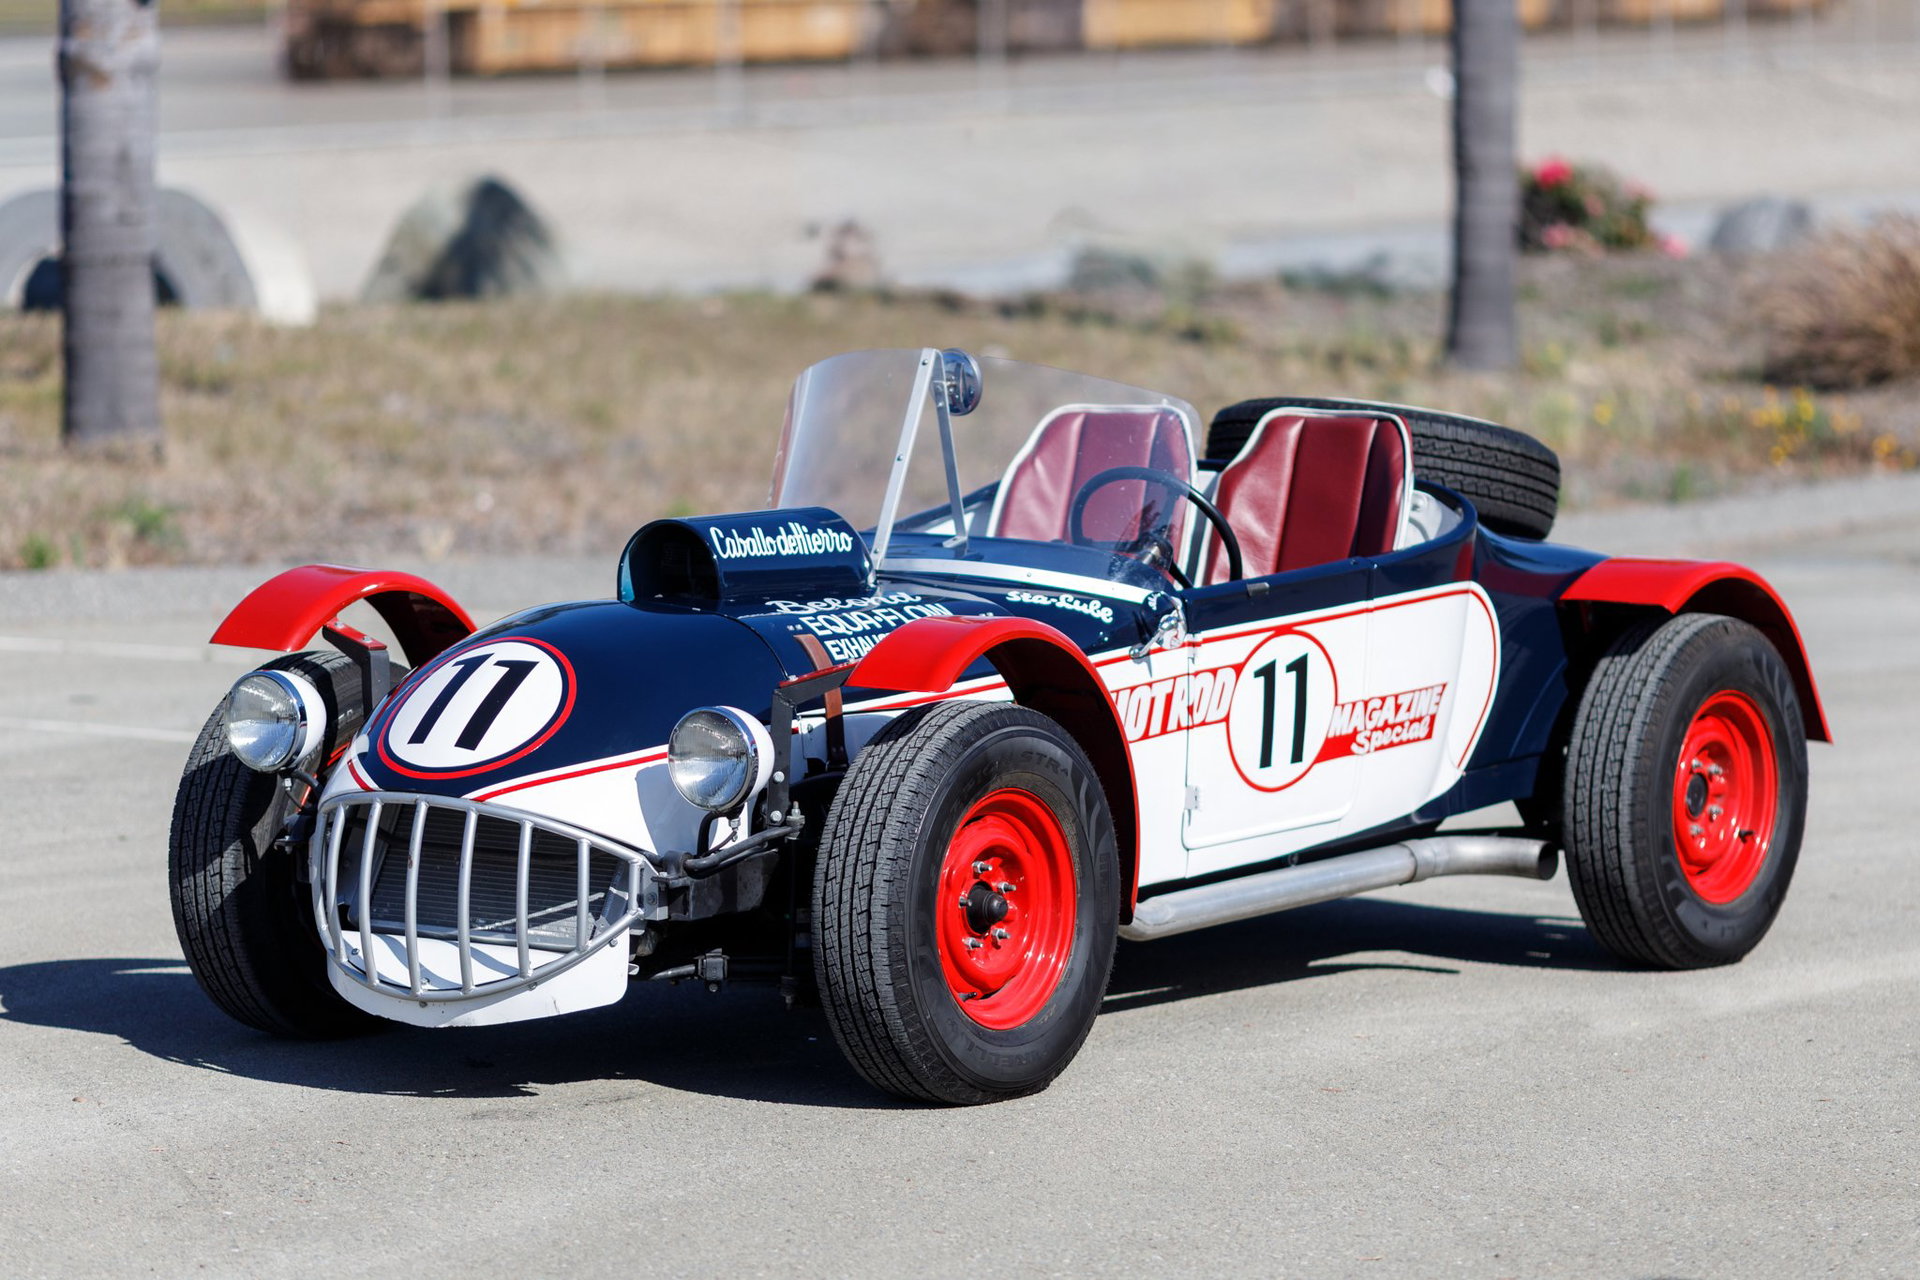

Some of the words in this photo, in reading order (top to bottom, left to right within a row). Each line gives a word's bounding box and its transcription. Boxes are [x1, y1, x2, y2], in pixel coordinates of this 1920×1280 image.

[407, 652, 541, 752] 11
[1253, 652, 1309, 769] 11
[1327, 684, 1444, 739] MAGAZINE
[1350, 714, 1432, 756] Special
